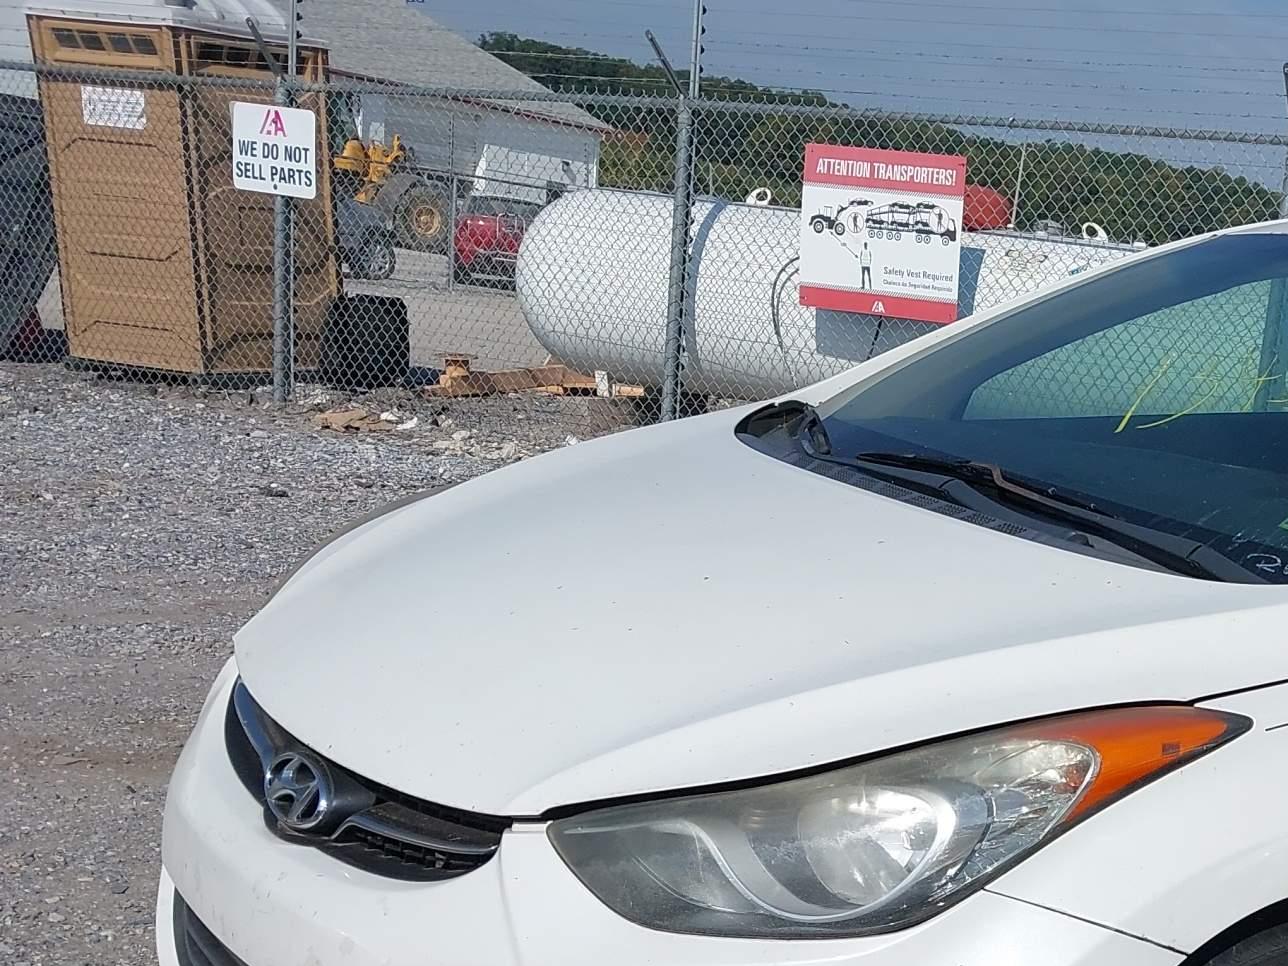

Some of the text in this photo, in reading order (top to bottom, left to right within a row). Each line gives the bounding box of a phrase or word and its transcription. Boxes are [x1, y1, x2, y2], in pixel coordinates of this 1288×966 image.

[238, 139, 310, 164] WE DO NOT
[235, 161, 313, 187] SELL PARTS
[816, 158, 957, 186] ATTENTION TRANSPORTERS!
[883, 266, 954, 283] Safety Vest Required
